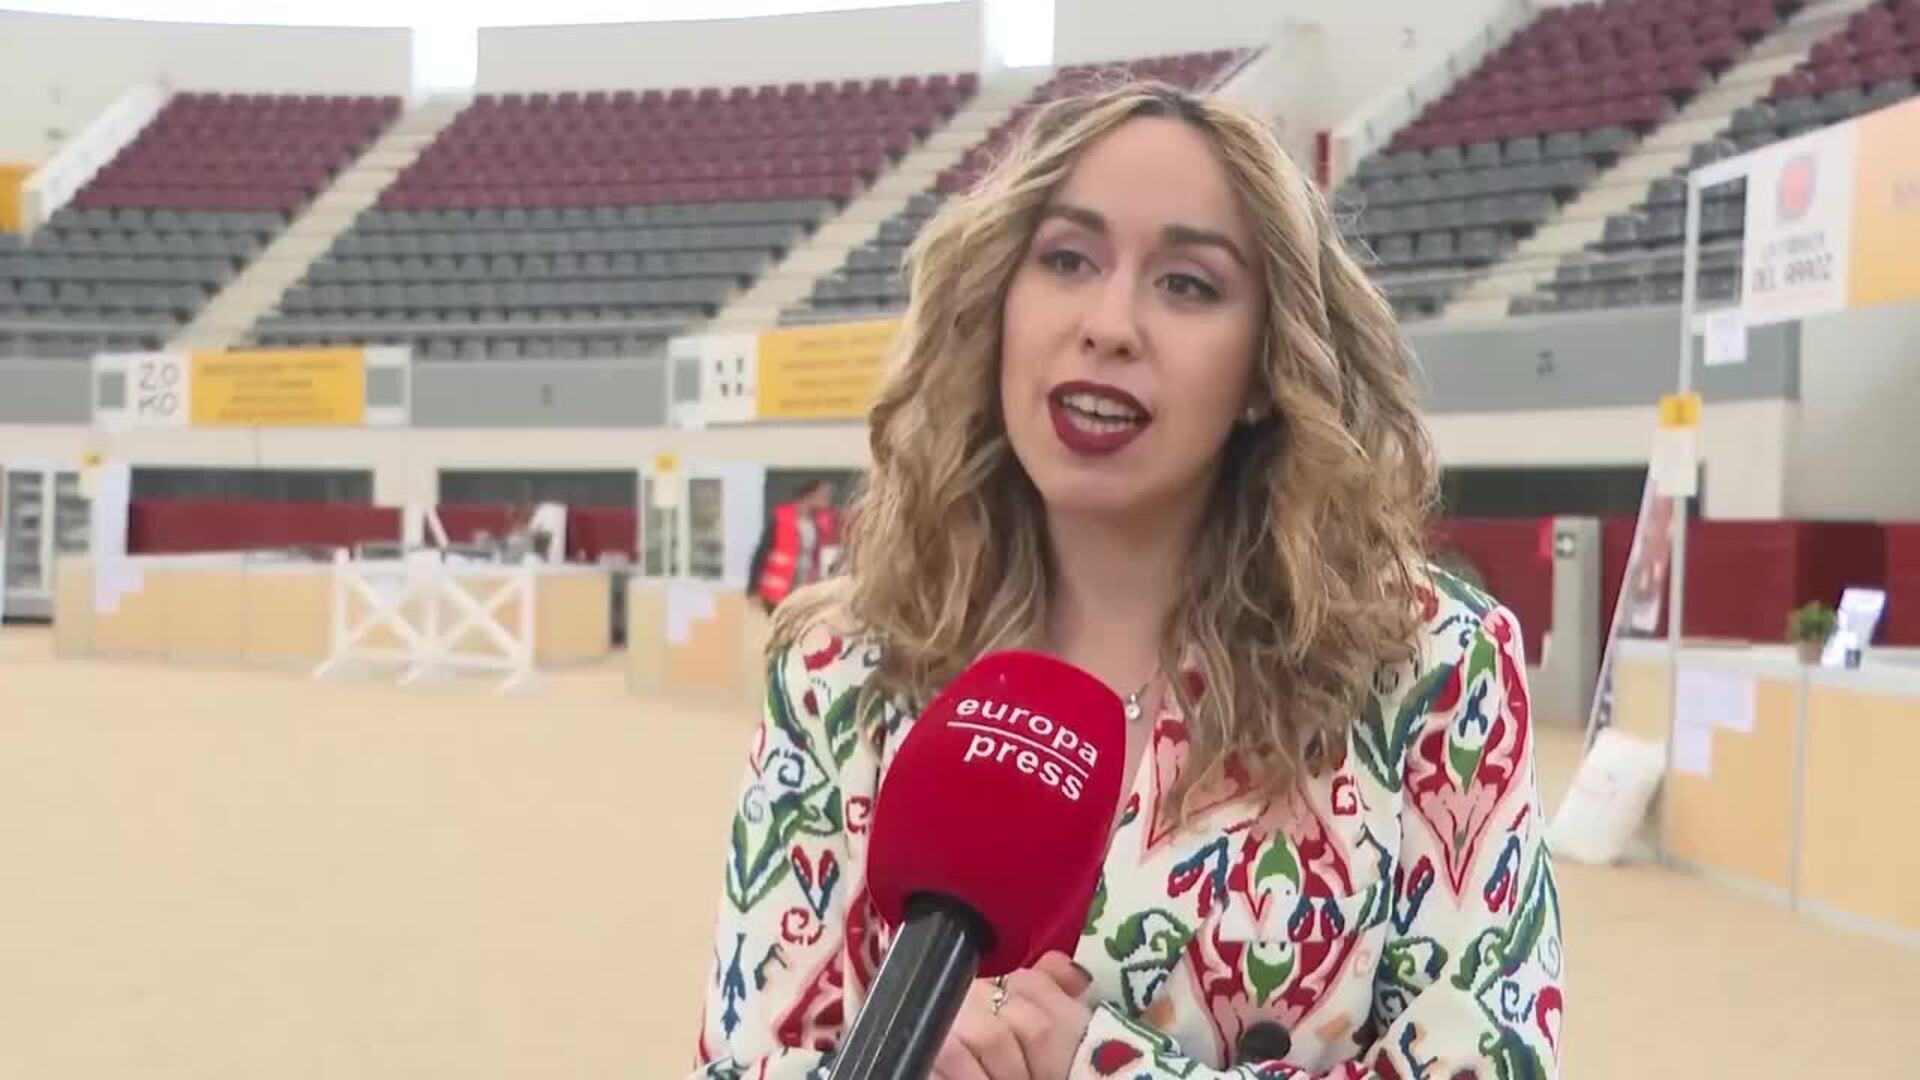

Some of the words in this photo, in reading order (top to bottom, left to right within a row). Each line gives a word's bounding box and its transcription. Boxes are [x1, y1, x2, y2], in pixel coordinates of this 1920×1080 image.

[1752, 265, 1777, 291] DEL
[956, 697, 1099, 769] europa
[963, 733, 1083, 801] press
